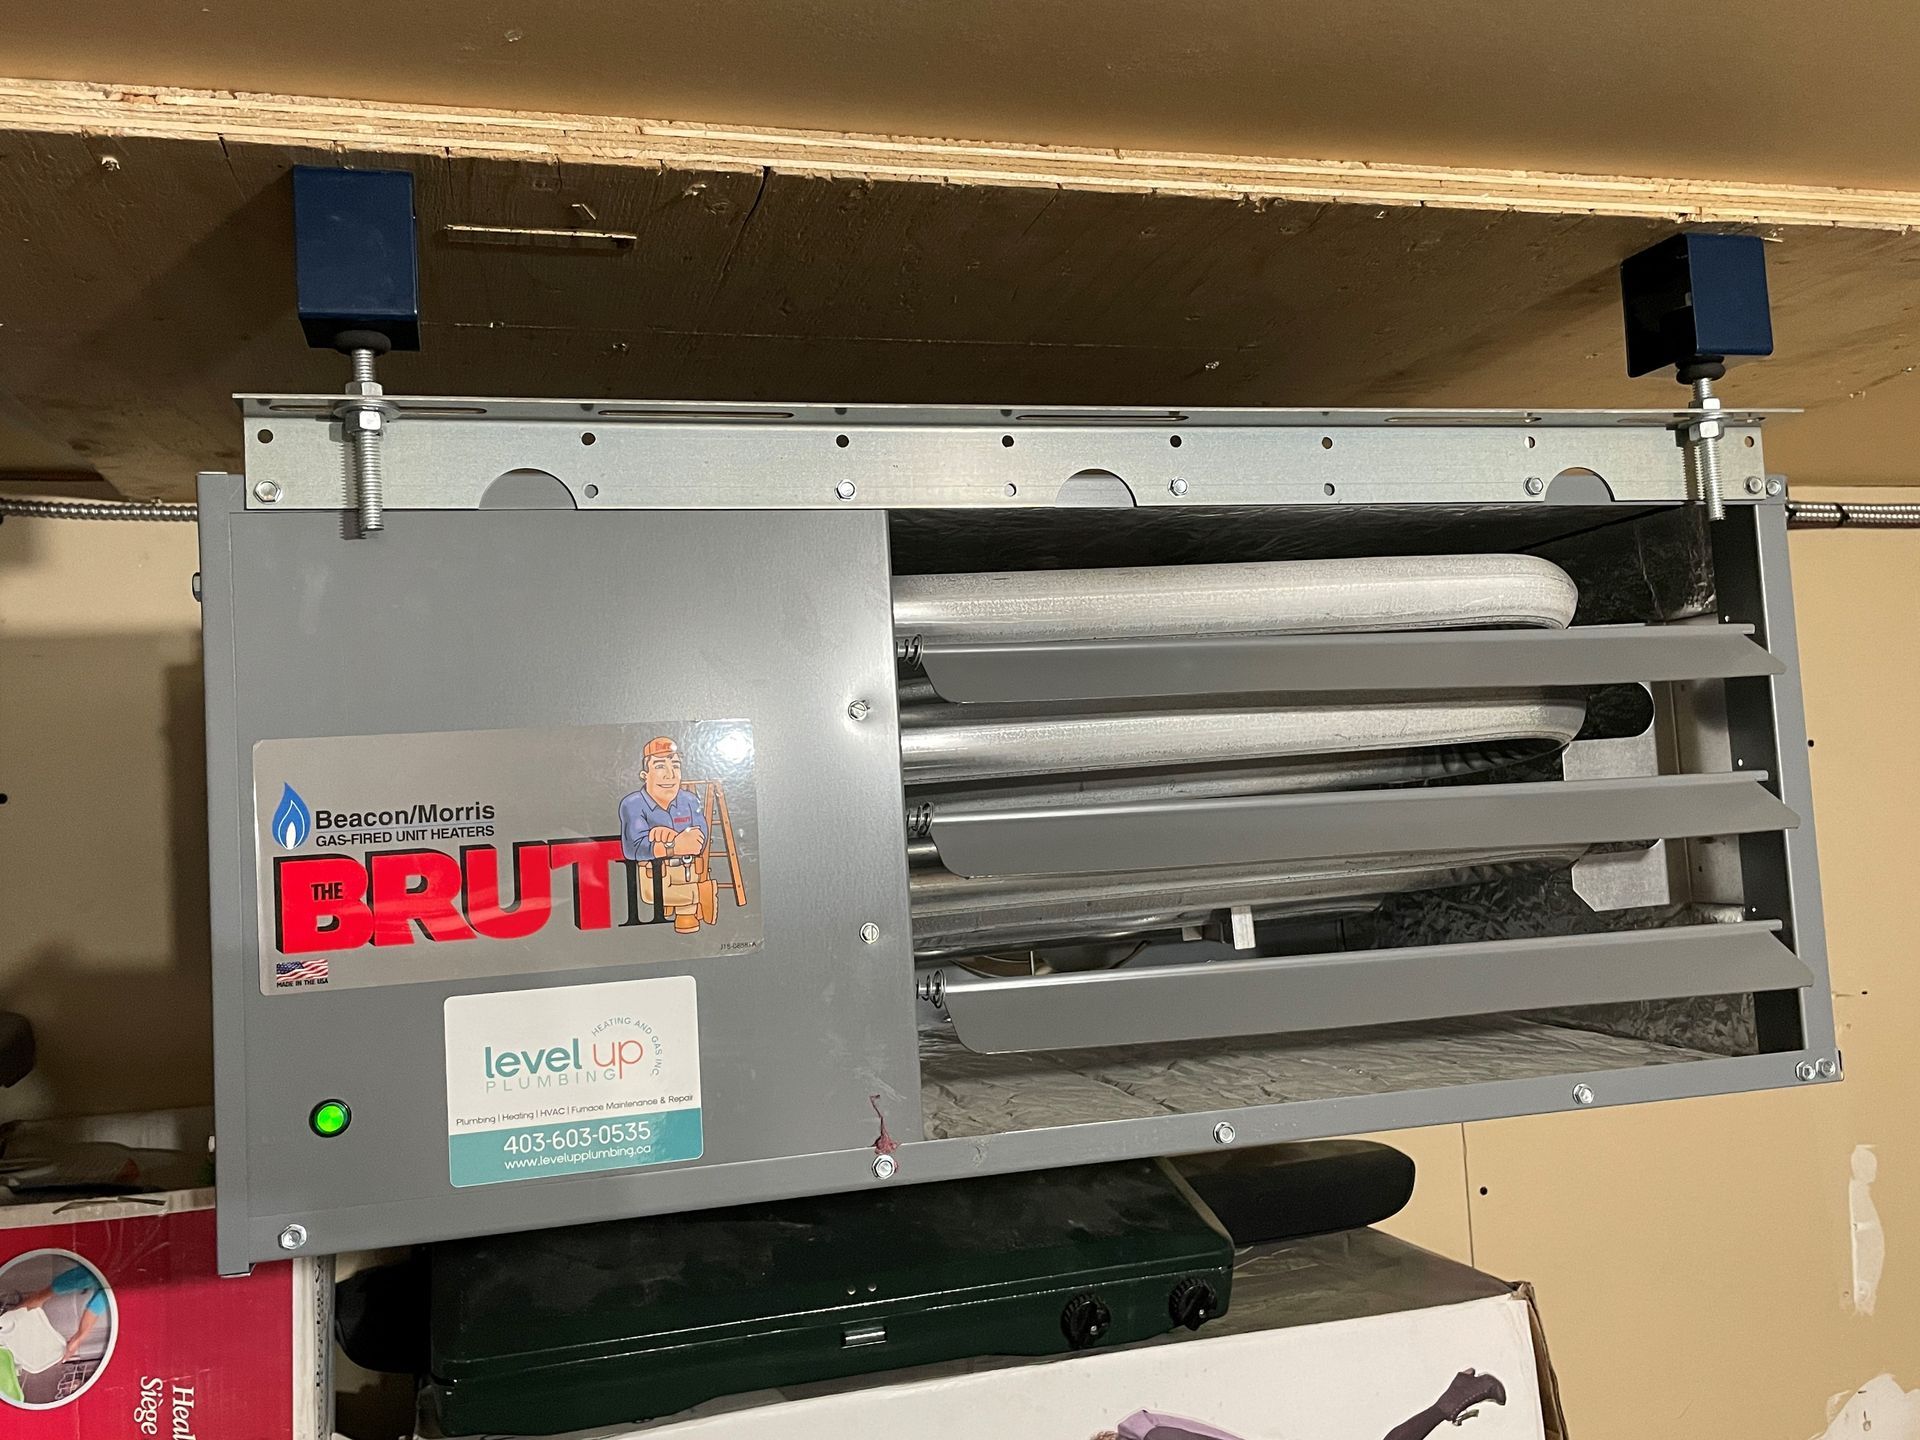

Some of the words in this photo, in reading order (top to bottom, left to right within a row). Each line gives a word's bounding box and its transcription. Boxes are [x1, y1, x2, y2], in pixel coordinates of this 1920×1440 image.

[315, 801, 495, 829] Beacon/Morris
[315, 832, 392, 847] GAS-FIRED
[395, 829, 427, 842] UNIT
[430, 825, 495, 839] HEATERS
[273, 835, 623, 954] BRUT
[311, 882, 344, 900] THE
[591, 1016, 631, 1037] HEATING
[634, 1020, 653, 1035] AND
[651, 1035, 663, 1056] GAS
[485, 1038, 582, 1078] level
[593, 1040, 643, 1079] up
[486, 1068, 616, 1093] PLUMBING
[456, 1115, 496, 1126] Plumbing
[502, 1110, 534, 1121] Heating
[540, 1107, 565, 1117] HVAC
[571, 1104, 604, 1114] Furnace
[606, 1099, 658, 1111] Maintenance
[660, 1096, 666, 1104] &
[668, 1094, 693, 1104] Repair
[504, 1121, 651, 1154] 403-603-0535
[504, 1144, 651, 1170] www.levelupplumbing.ca
[133, 1375, 164, 1435] Siège
